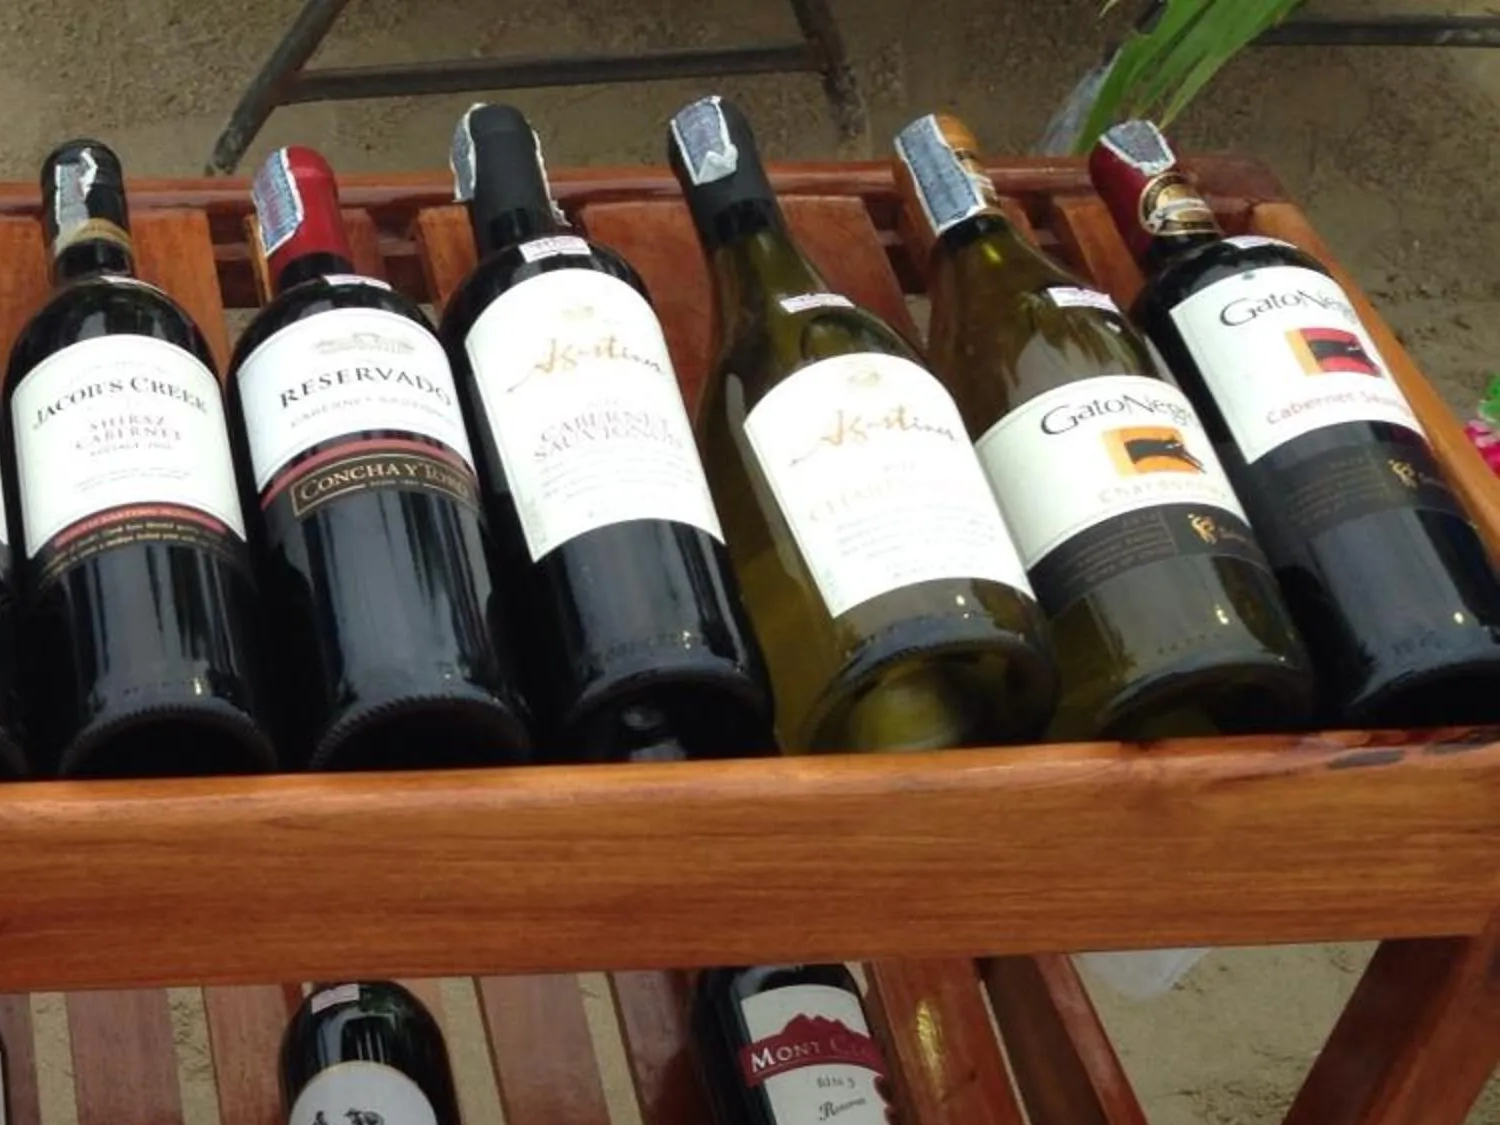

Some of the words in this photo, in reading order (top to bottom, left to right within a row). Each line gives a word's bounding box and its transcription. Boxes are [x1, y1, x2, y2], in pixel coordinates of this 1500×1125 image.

[32, 379, 123, 431] JACOB'S
[130, 376, 208, 415] CREEK
[280, 366, 451, 408] RESERVADO
[301, 463, 401, 500] CONCHA
[751, 1041, 820, 1073] MONT
